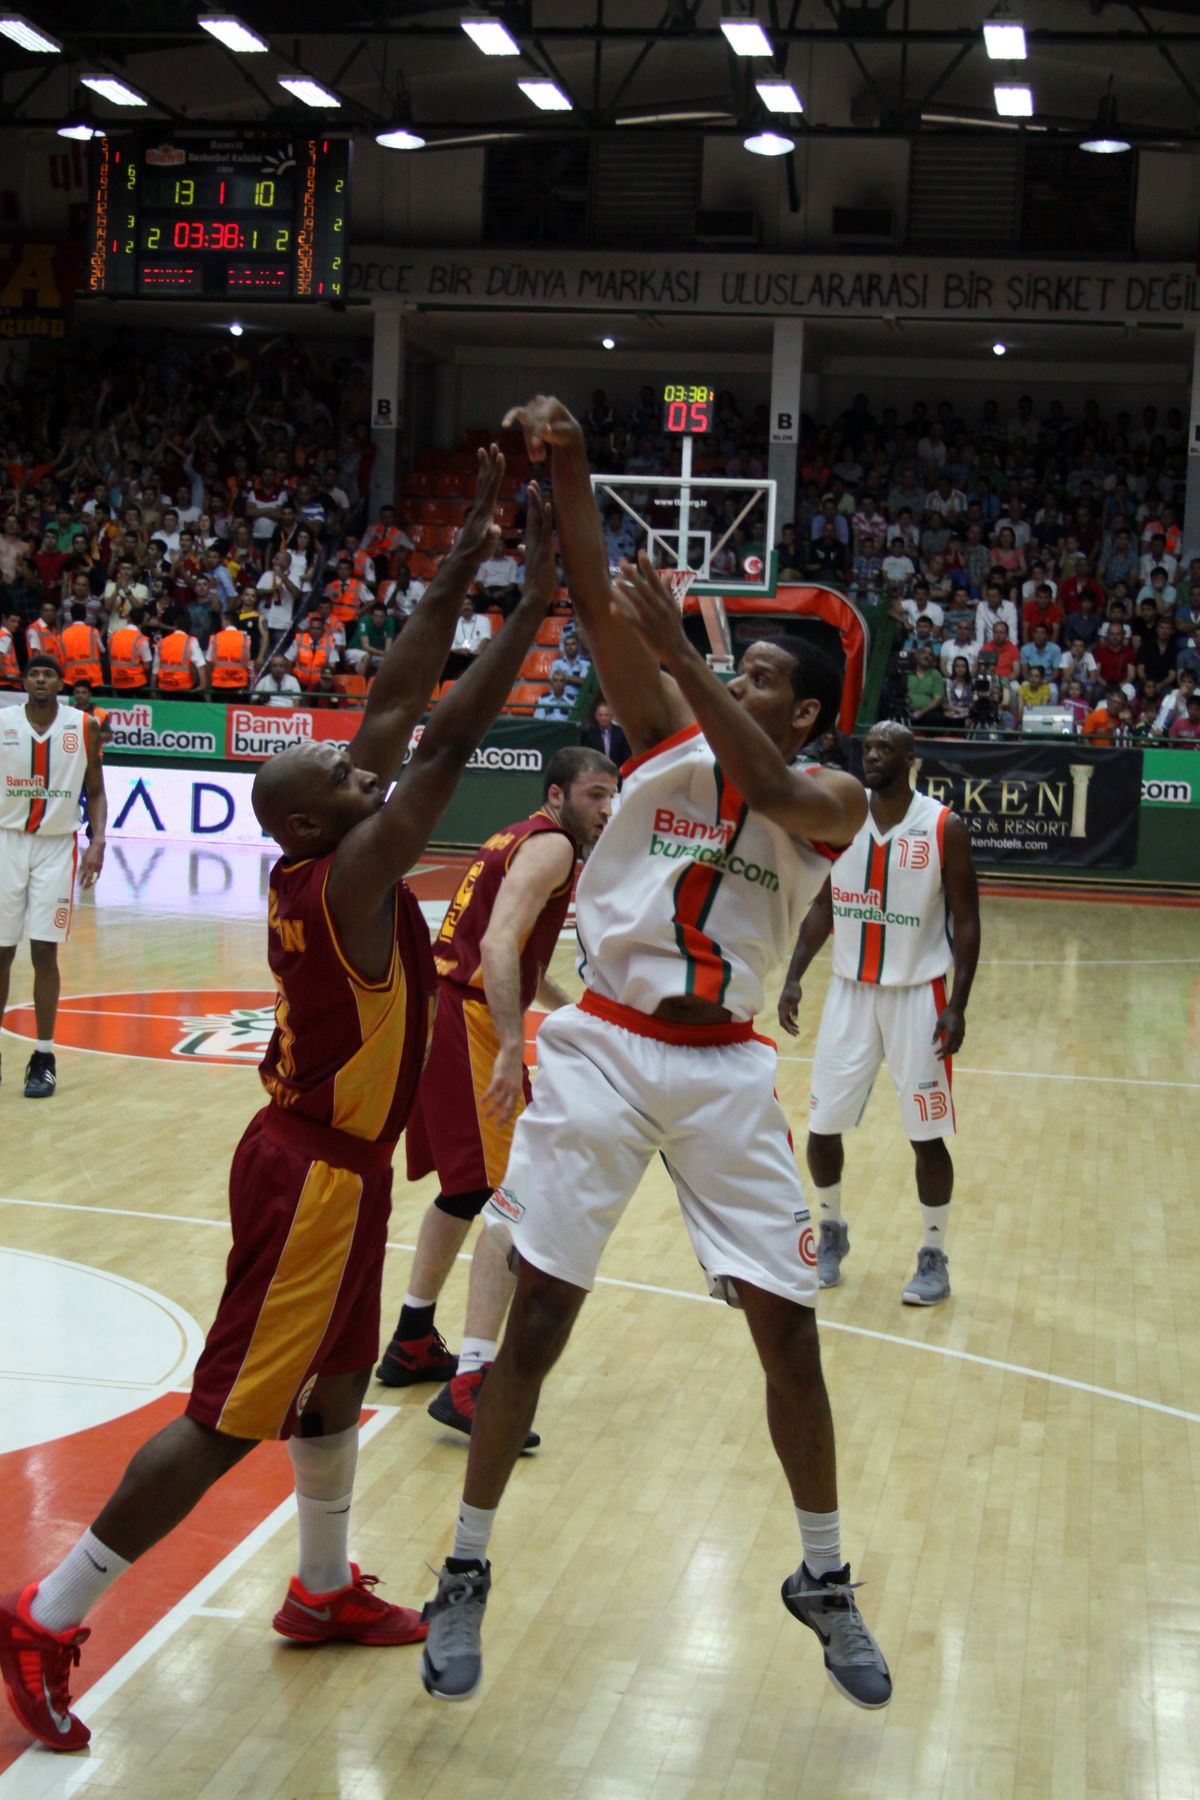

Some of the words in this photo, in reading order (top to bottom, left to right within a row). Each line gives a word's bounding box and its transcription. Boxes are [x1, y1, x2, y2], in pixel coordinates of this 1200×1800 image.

[127, 164, 136, 177] 6
[127, 177, 136, 190] 2
[335, 180, 344, 193] 2
[174, 179, 195, 206] 13
[218, 179, 226, 206] 1
[254, 181, 275, 207] 10
[128, 215, 136, 228] 3
[333, 218, 343, 232] 2
[125, 241, 135, 254] 2
[147, 228, 160, 249] 2
[276, 229, 289, 251] 2
[332, 257, 342, 270] 2
[332, 282, 341, 296] 4
[428, 263, 472, 295] BİR
[487, 263, 567, 298] DÜNYA
[578, 269, 699, 302] MARKASI
[722, 271, 928, 309] ULUSLARARASI
[944, 270, 993, 309] BİR
[1007, 272, 1115, 312] ŞİRKET
[664, 385, 708, 402] 03:38
[378, 399, 391, 415] B
[667, 402, 708, 432] 05
[777, 413, 792, 429] B
[236, 713, 310, 736] Banvit
[63, 733, 79, 753] 8
[6, 774, 43, 787] Banvit
[654, 808, 736, 845] Banvit
[986, 818, 1000, 833] &
[1004, 819, 1069, 837] RESORT
[971, 836, 1048, 850] kenhotels.com
[649, 834, 780, 892] burada.com
[898, 838, 930, 870] 13
[832, 886, 879, 906] Banvit
[54, 907, 69, 928] 8
[913, 1091, 948, 1123] 13
